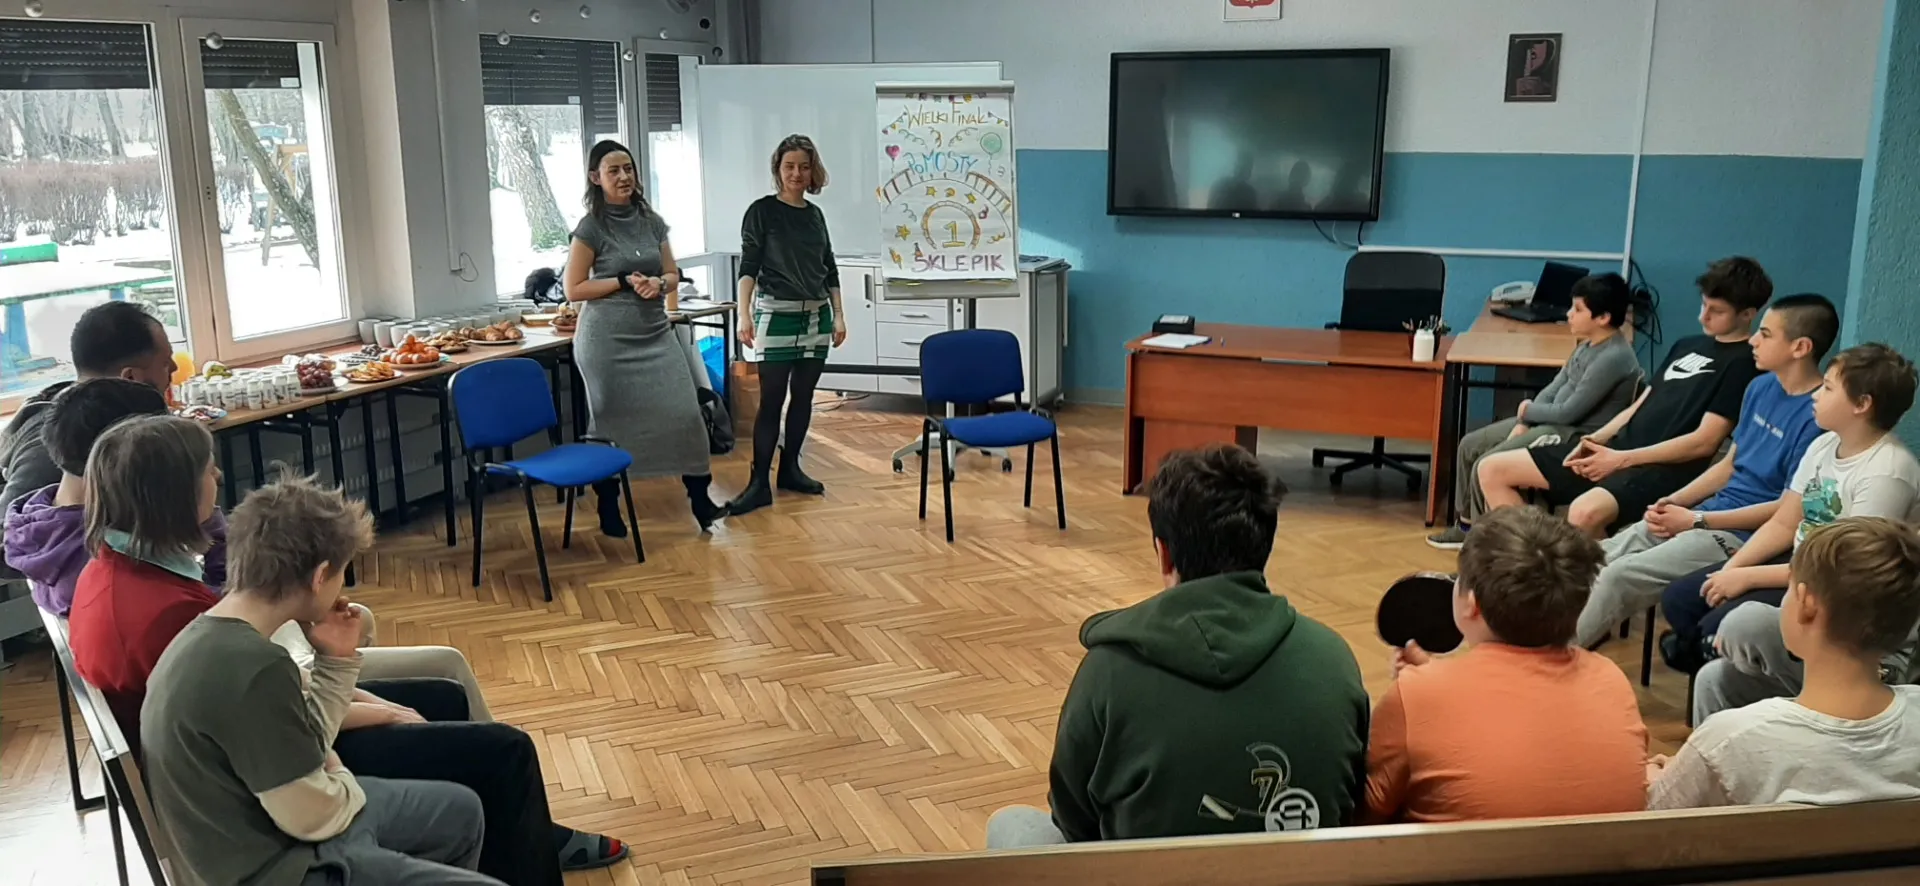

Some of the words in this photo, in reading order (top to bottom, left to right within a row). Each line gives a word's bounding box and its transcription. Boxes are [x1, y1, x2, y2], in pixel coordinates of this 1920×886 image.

[903, 104, 949, 129] WIELKI
[902, 149, 979, 175] POMOSTY
[942, 220, 966, 248] 1
[911, 254, 1006, 273] SKLEPIK
